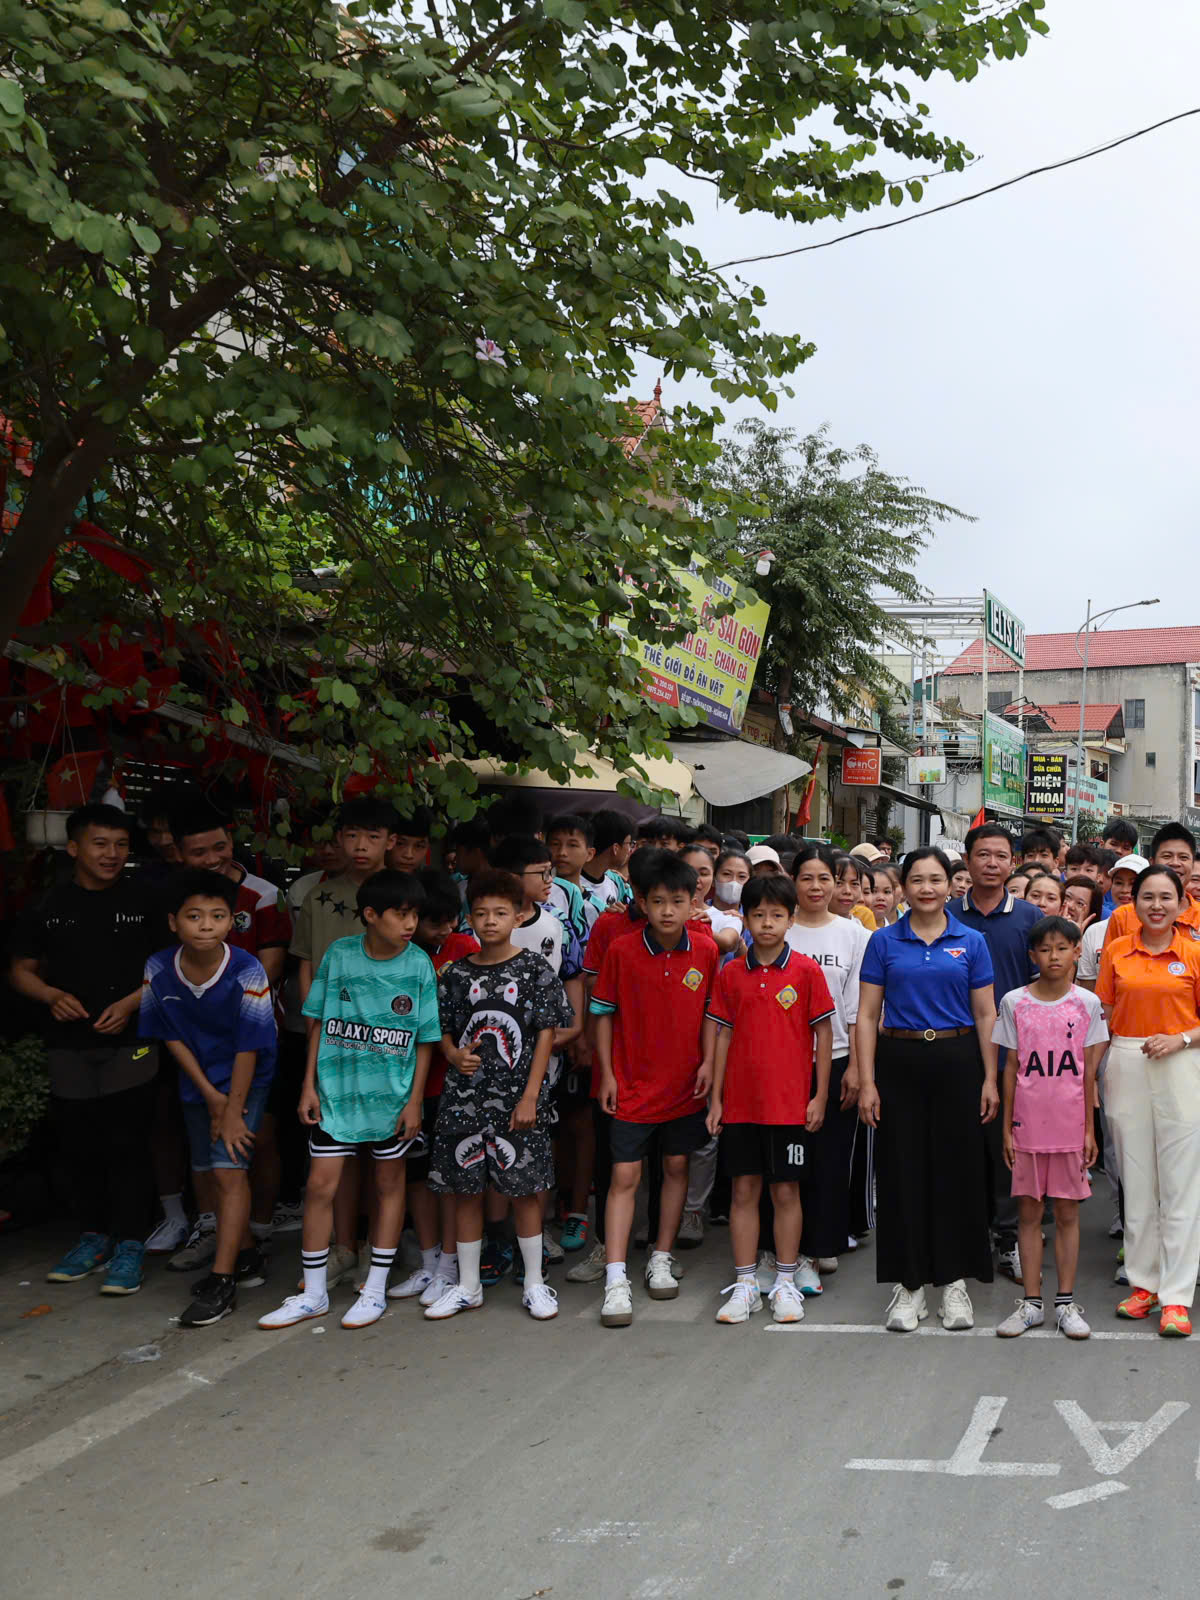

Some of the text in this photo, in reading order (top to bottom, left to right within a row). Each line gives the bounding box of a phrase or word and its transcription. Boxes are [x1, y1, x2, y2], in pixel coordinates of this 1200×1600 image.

[991, 601, 1012, 648] IELTS
[643, 643, 663, 666] THẾ
[664, 656, 682, 676] GIỚI
[684, 662, 695, 681] ĐỒ
[1030, 792, 1064, 806] THOẠI
[372, 1027, 412, 1047] SPORT
[1024, 1050, 1079, 1077] AIA
[786, 1143, 804, 1166] 18
